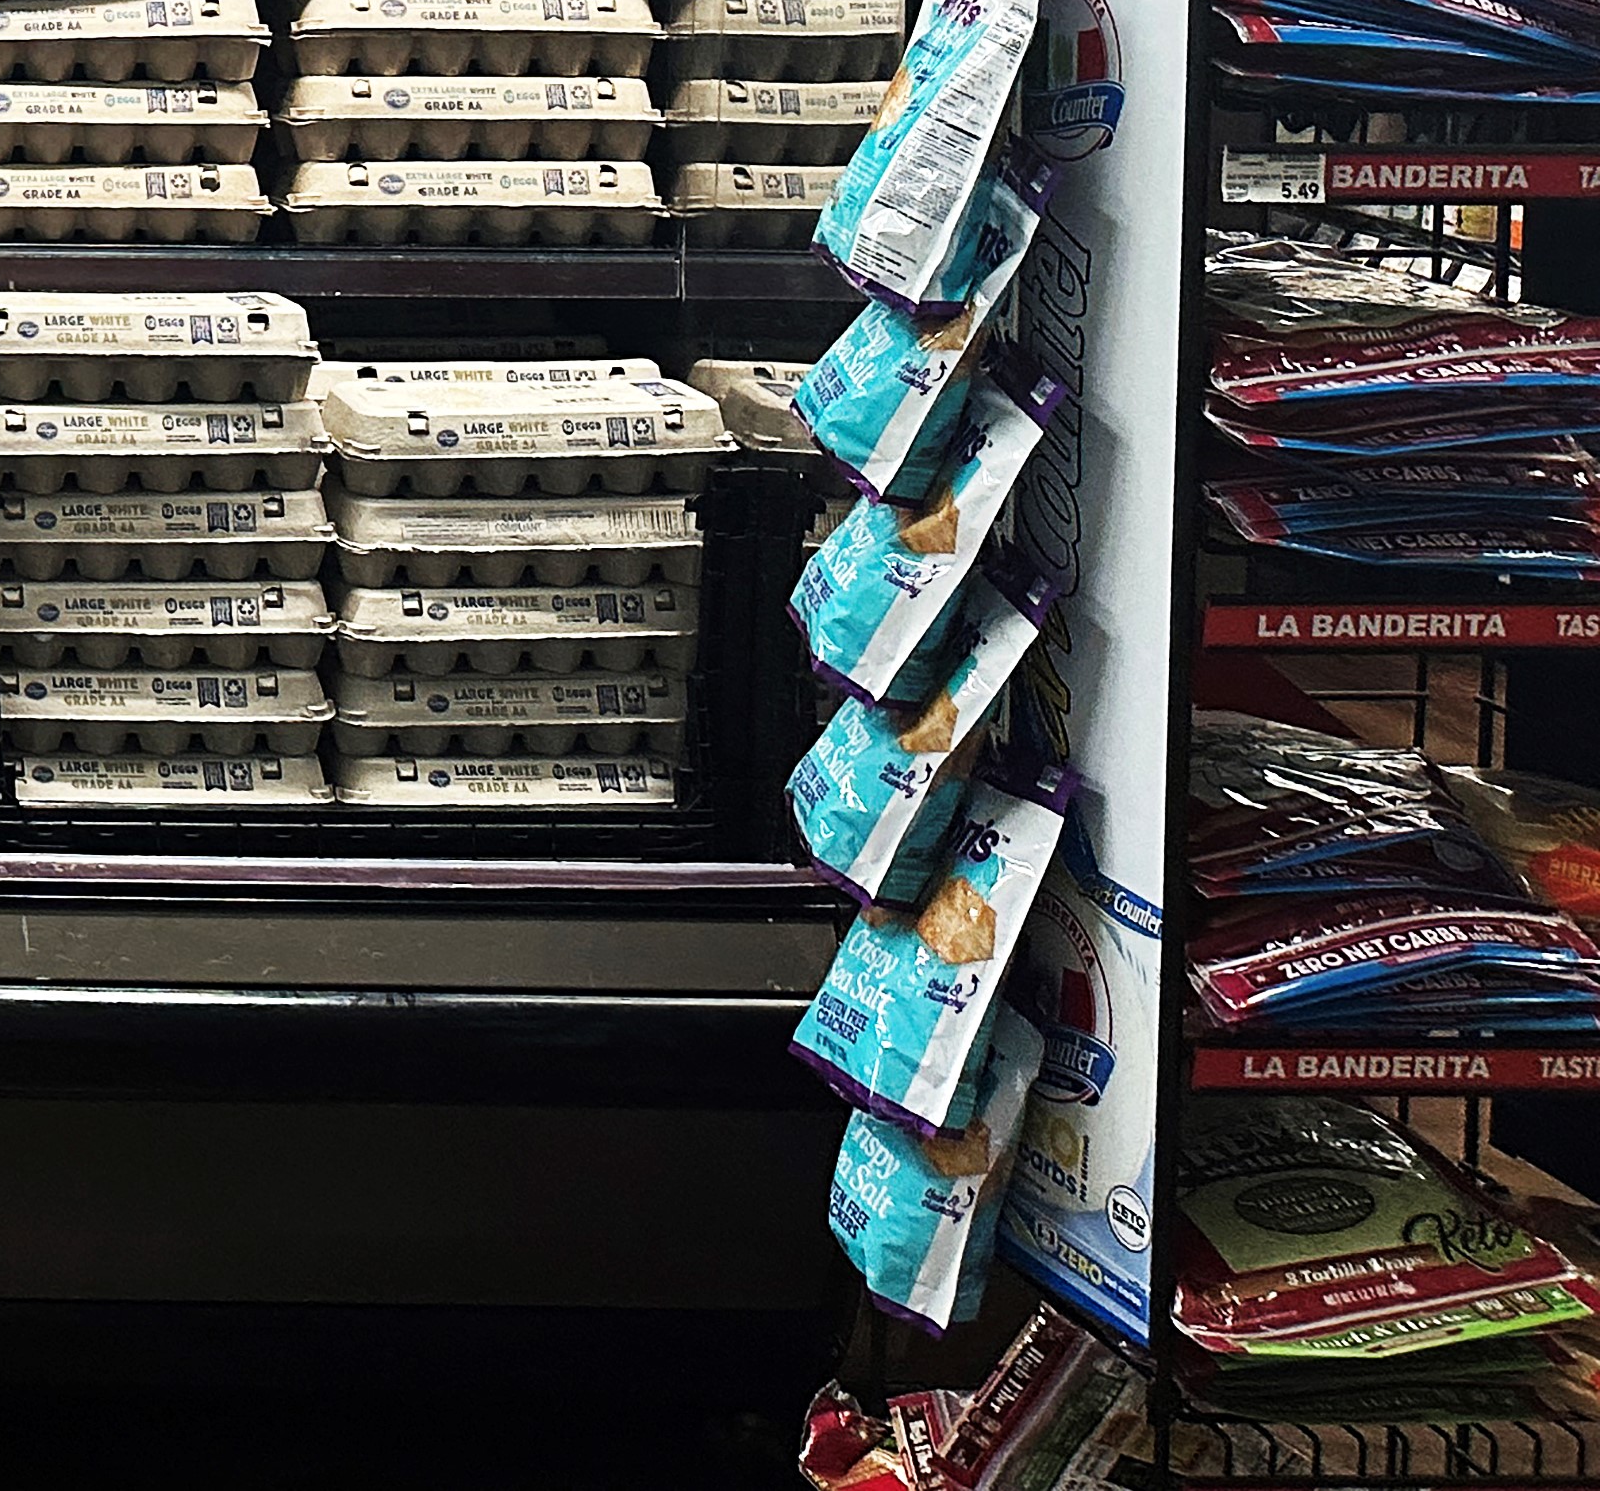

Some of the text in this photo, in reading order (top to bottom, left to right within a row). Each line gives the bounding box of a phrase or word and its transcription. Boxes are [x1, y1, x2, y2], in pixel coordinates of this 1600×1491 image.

[425, 101, 482, 112] GRADE AA
[1331, 164, 1529, 189] BANDERITA
[1281, 183, 1320, 200] 5.49
[44, 315, 131, 327] LARGE WHITE
[56, 332, 118, 344] GRADE AA
[1257, 613, 1300, 637] LA
[1311, 613, 1507, 637] BANDERITA
[847, 927, 900, 979] Crispy
[1277, 924, 1469, 981] ZERO NET CARBS
[1243, 1056, 1491, 1079] LA BANDERITA
[1112, 1201, 1146, 1228] KETO
[1401, 1208, 1514, 1275] Keto
[1057, 1242, 1103, 1286] ZERO
